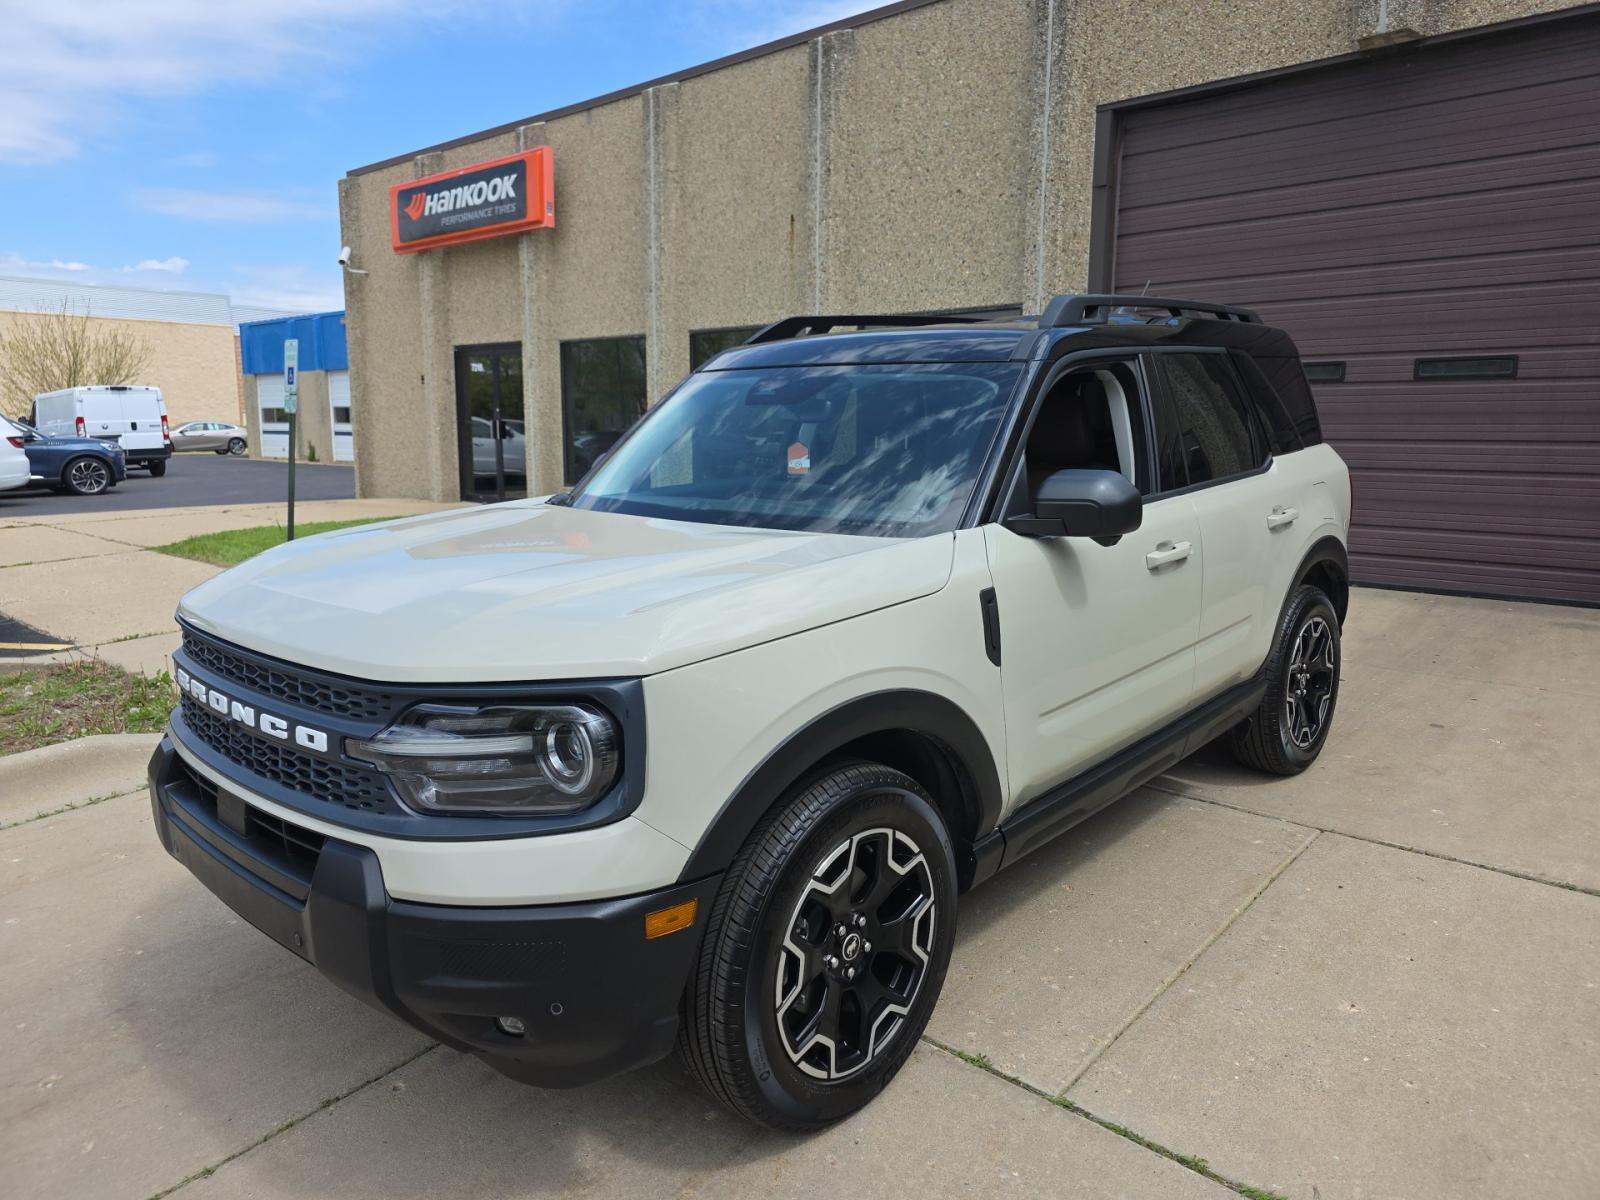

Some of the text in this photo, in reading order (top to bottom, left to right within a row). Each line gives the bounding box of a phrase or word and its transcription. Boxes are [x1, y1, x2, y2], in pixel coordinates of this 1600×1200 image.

[441, 203, 517, 226] PERFORMANCE TIRES
[177, 668, 328, 752] BRONCO
